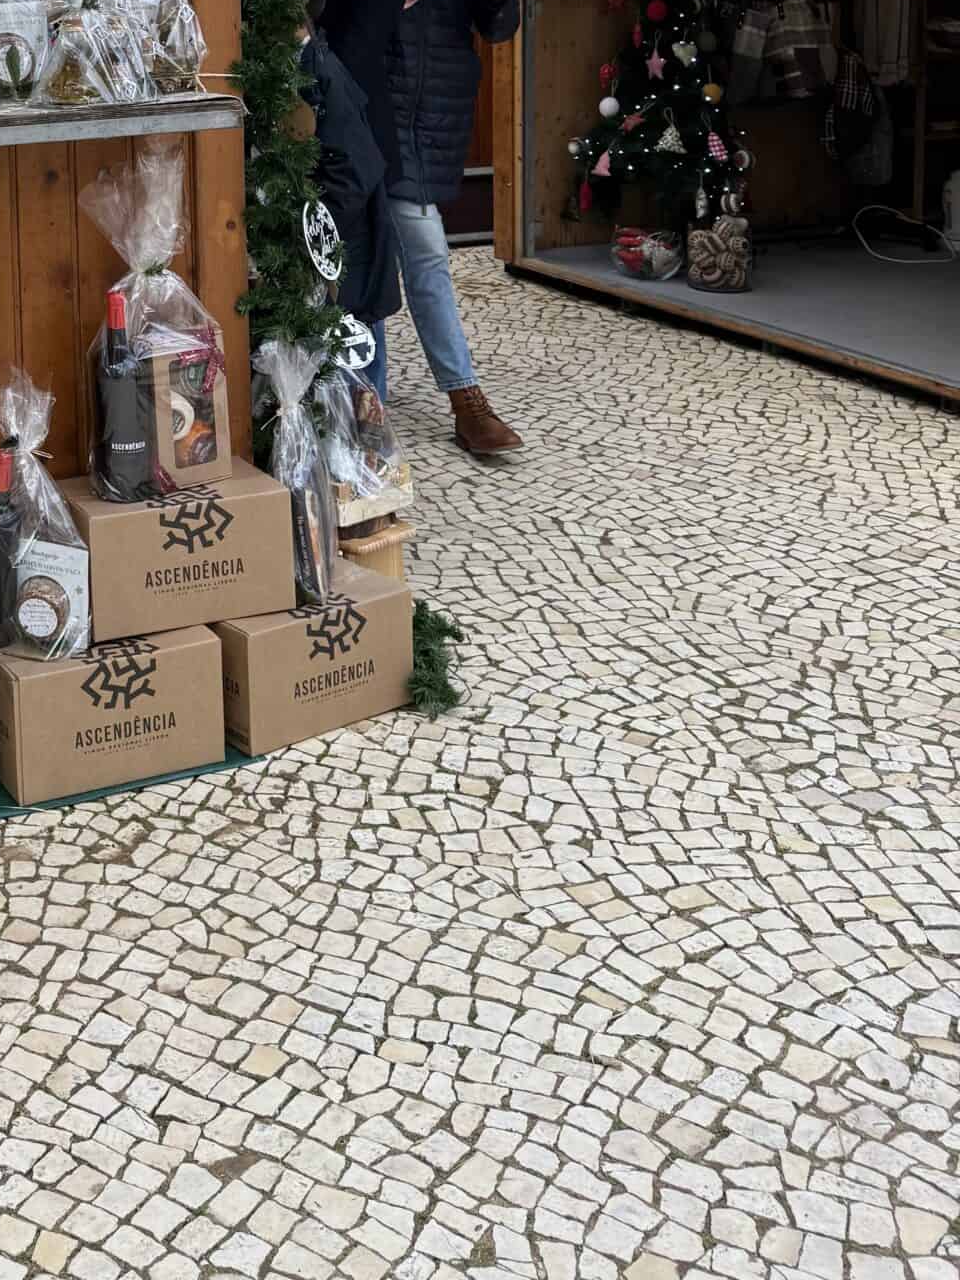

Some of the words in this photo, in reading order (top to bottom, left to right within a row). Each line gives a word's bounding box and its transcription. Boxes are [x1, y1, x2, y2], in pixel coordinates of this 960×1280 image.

[144, 557, 245, 589] ASCENDÊNCIA
[294, 658, 375, 700] ASCENDÊNCIA
[75, 711, 177, 750] ASCENDÊNCIA
